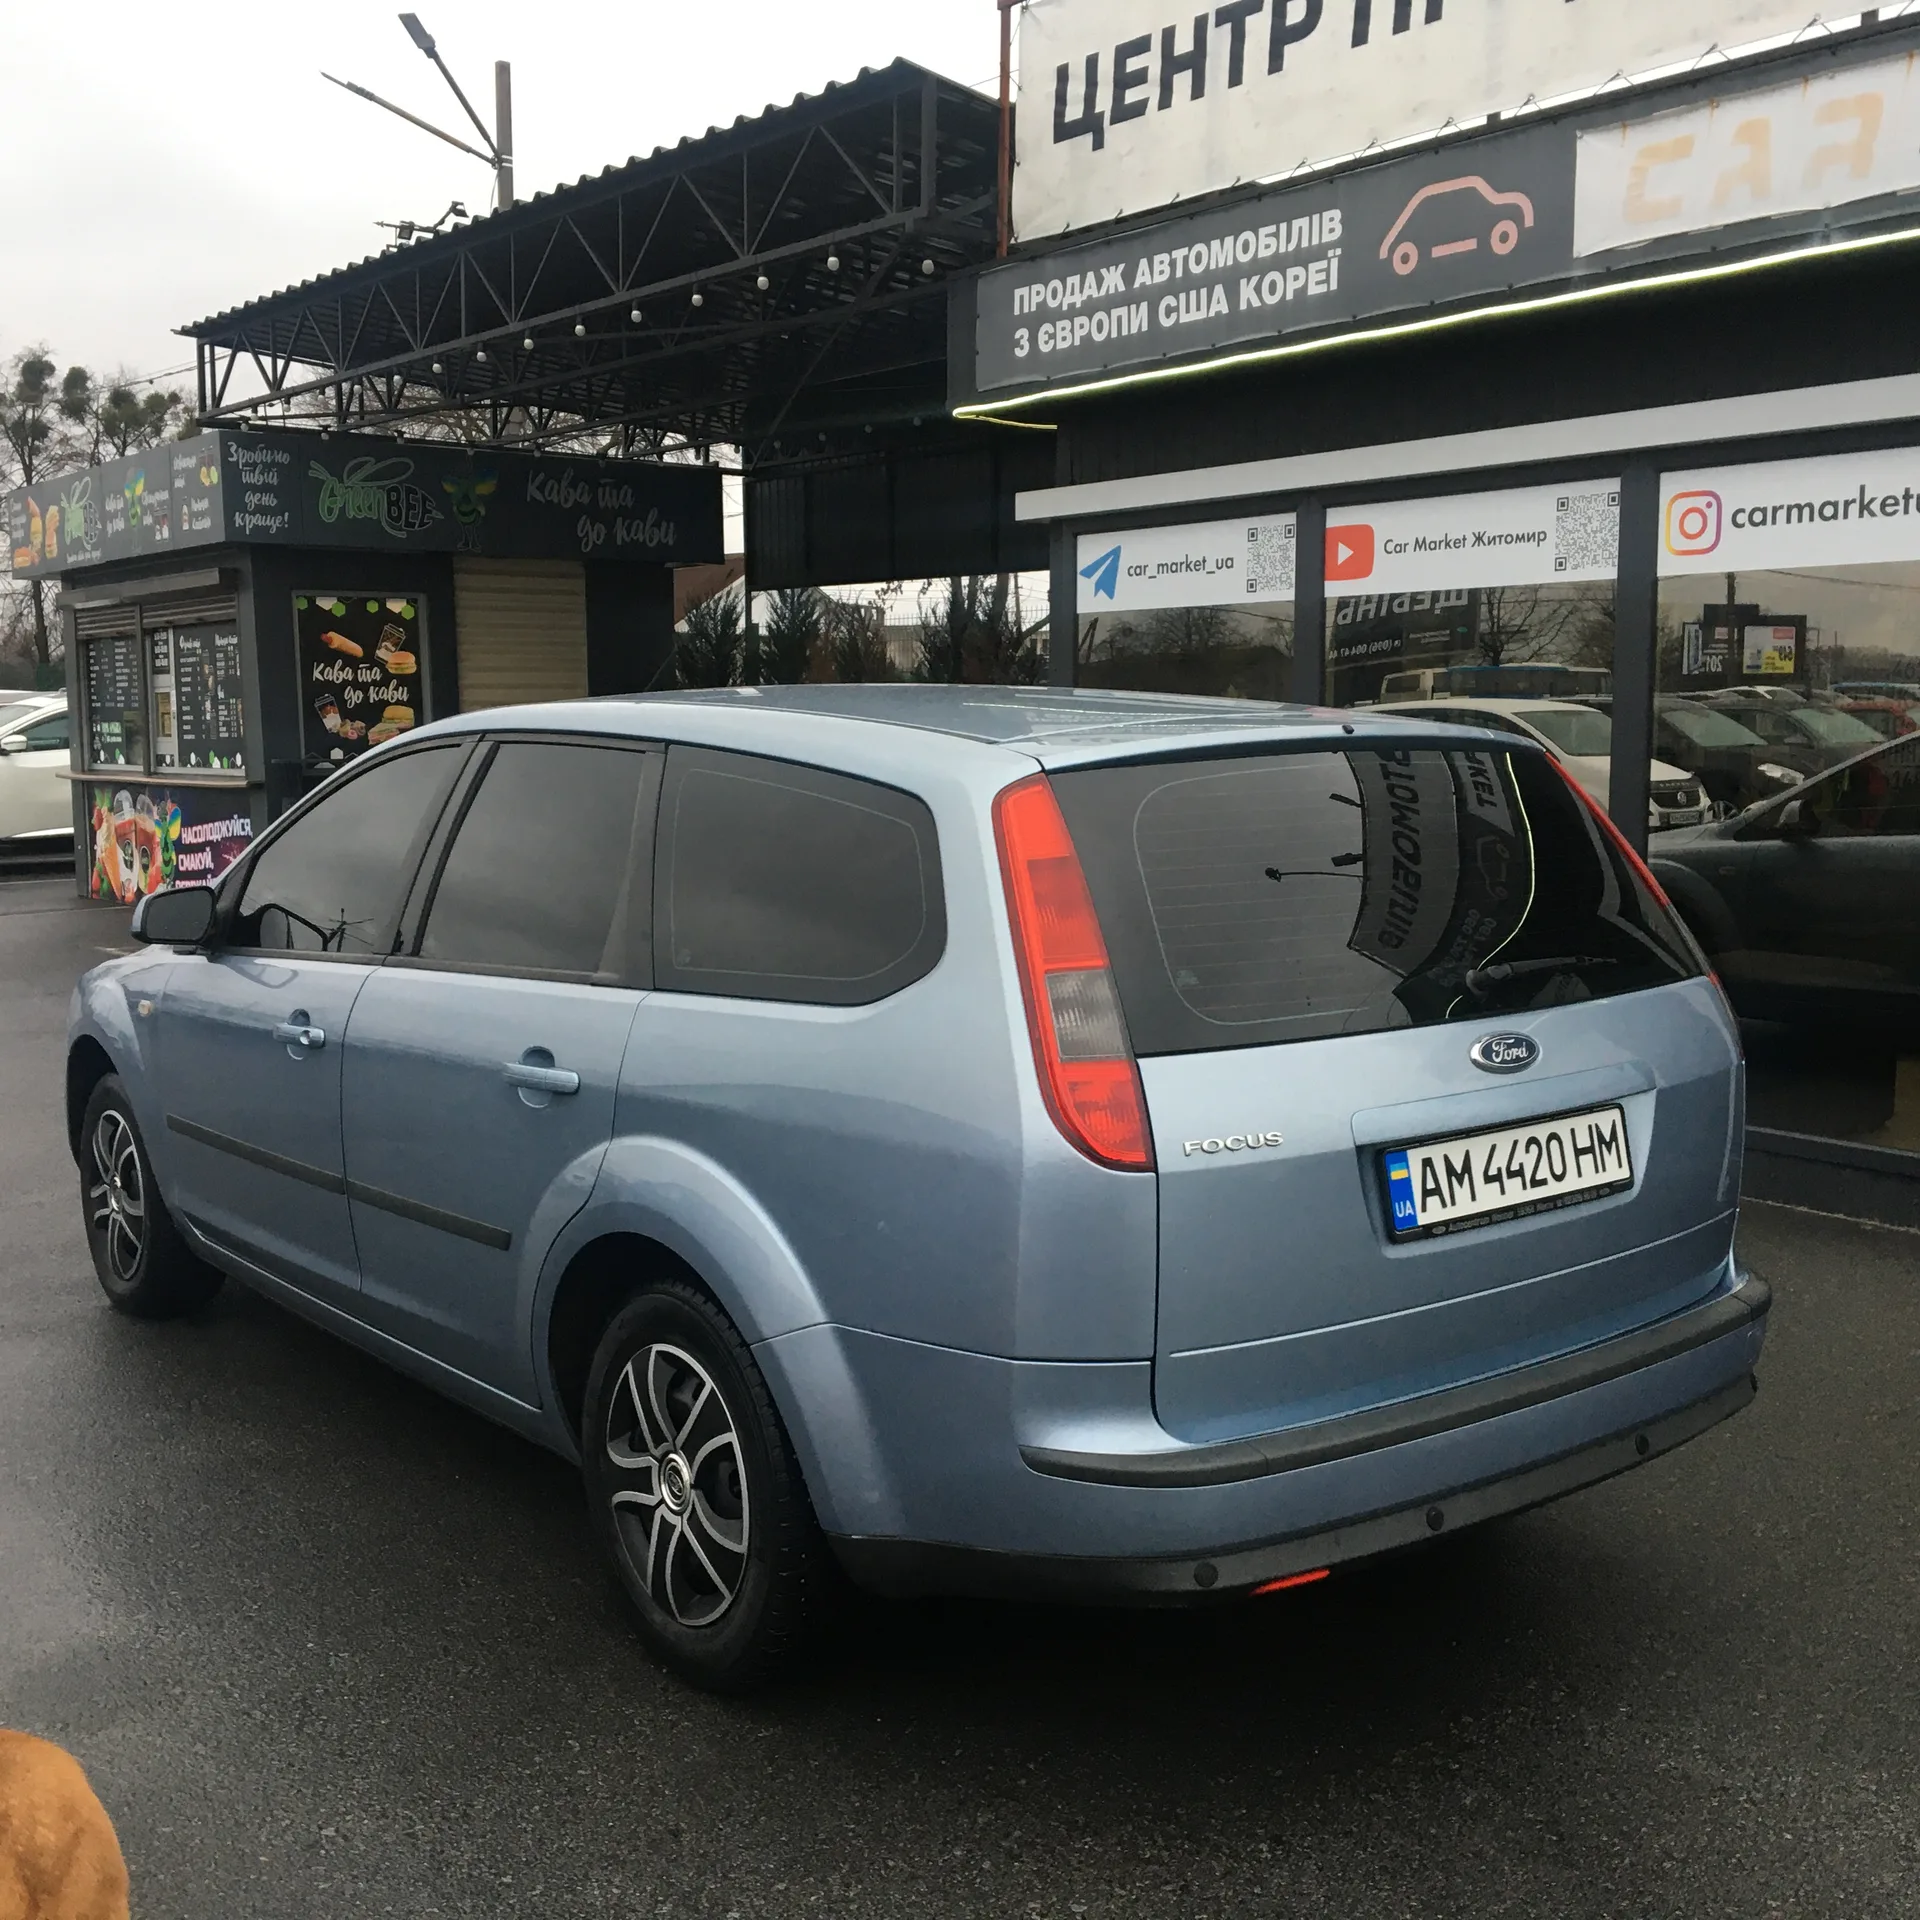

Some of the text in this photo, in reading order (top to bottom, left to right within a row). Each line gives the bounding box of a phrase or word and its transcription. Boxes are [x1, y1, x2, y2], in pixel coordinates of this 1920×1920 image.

[1053, 0, 1324, 151] ЦЕНТР
[1013, 208, 1344, 316] ПРОДАЖ АВТОМОБІЛІВ
[1013, 248, 1343, 358] З ЄВРОПИ США КОРЕЇ
[227, 441, 291, 469] Зробимо
[242, 465, 279, 486] твій
[526, 466, 593, 508] Кава
[244, 491, 278, 512] день
[1731, 484, 1920, 529] carmarket
[233, 511, 289, 535] краще!
[577, 507, 677, 552] до кави
[1383, 530, 1548, 555] Car Market Житомир
[1127, 554, 1235, 579] car_market_ua
[312, 658, 383, 684] Кава та
[343, 678, 410, 709] до кави
[181, 813, 254, 845] НАСОЛОДЖУЙСЯ,
[178, 846, 215, 872] СМАКУЙ,
[1491, 1038, 1529, 1063] Ford
[1183, 1131, 1284, 1157] FOCUS
[1395, 1199, 1415, 1218] UA
